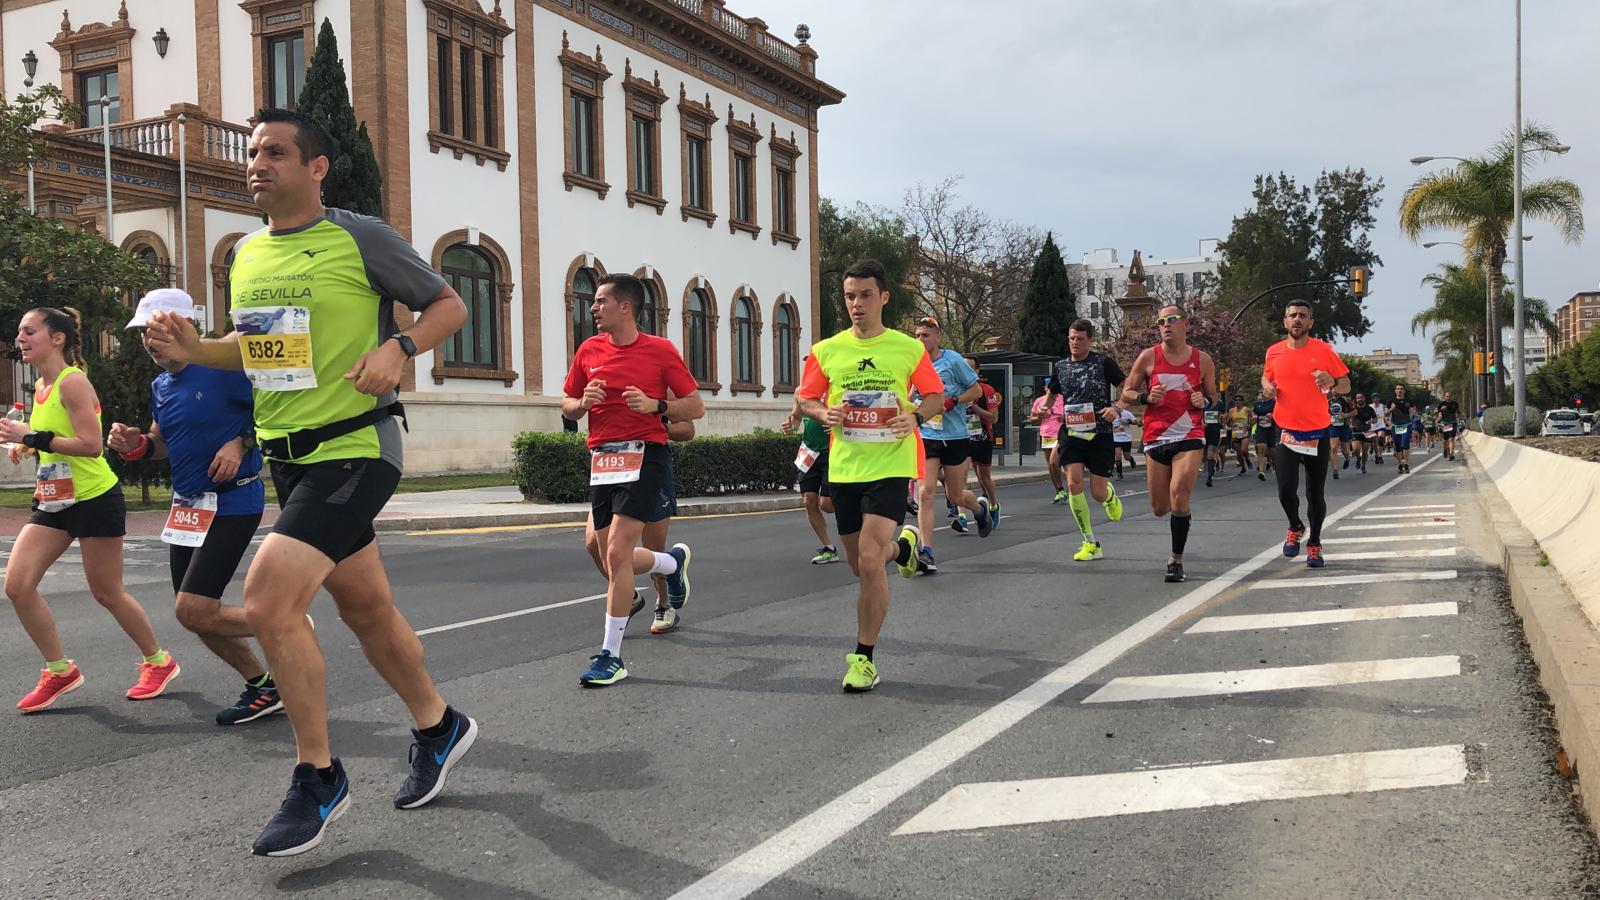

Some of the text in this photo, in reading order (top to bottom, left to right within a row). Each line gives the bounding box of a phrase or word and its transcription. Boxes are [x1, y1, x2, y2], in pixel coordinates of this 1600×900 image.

[272, 273, 314, 282] MARATÓN
[251, 287, 312, 301] SEVILLA
[248, 340, 285, 359] 6382
[847, 410, 878, 423] 4739
[596, 456, 625, 468] 4193
[174, 510, 199, 525] 5045
